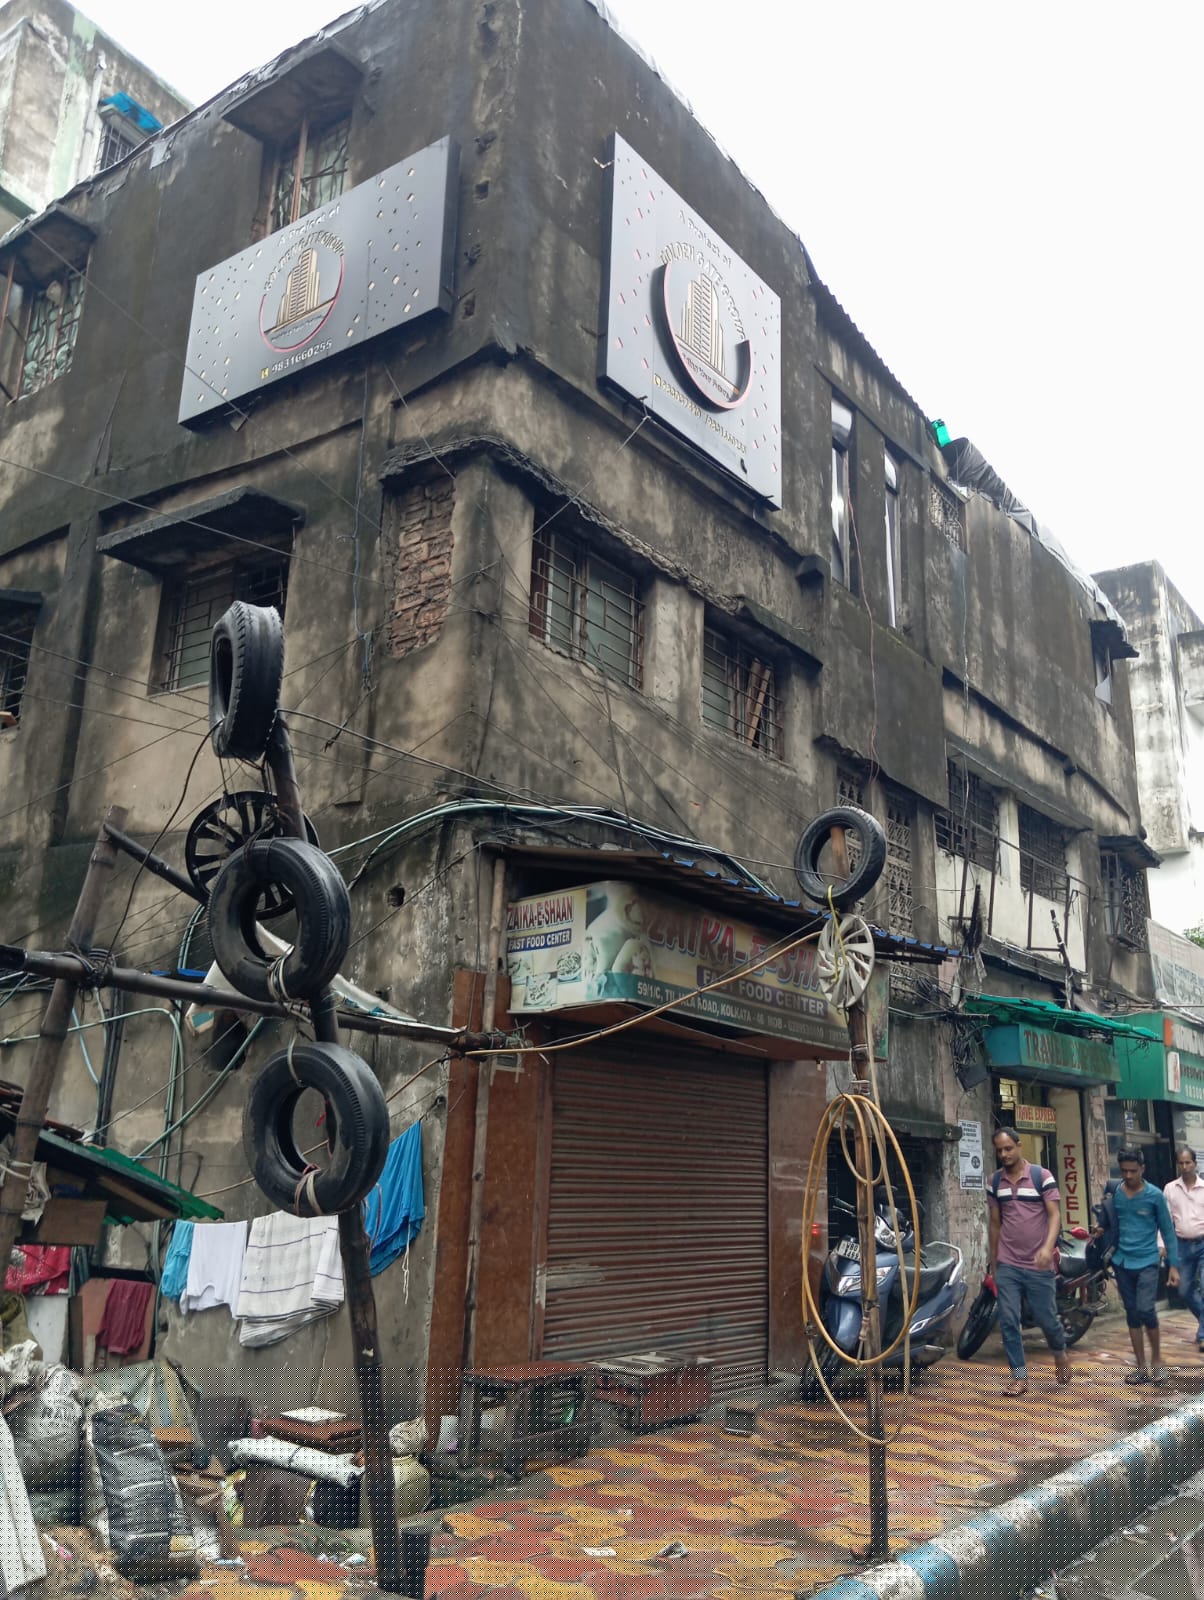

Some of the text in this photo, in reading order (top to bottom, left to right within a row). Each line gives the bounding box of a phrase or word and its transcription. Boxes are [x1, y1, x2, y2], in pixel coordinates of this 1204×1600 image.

[659, 240, 695, 265] GOLDEN
[696, 250, 723, 287] GATE
[506, 895, 574, 931] ZAIKA-E-SHAAN
[508, 930, 571, 951] FAST FOOD CENTER
[739, 980, 773, 1003] FOOD
[775, 989, 825, 1017] CENTER
[1063, 1144, 1080, 1225] TRAVEL
